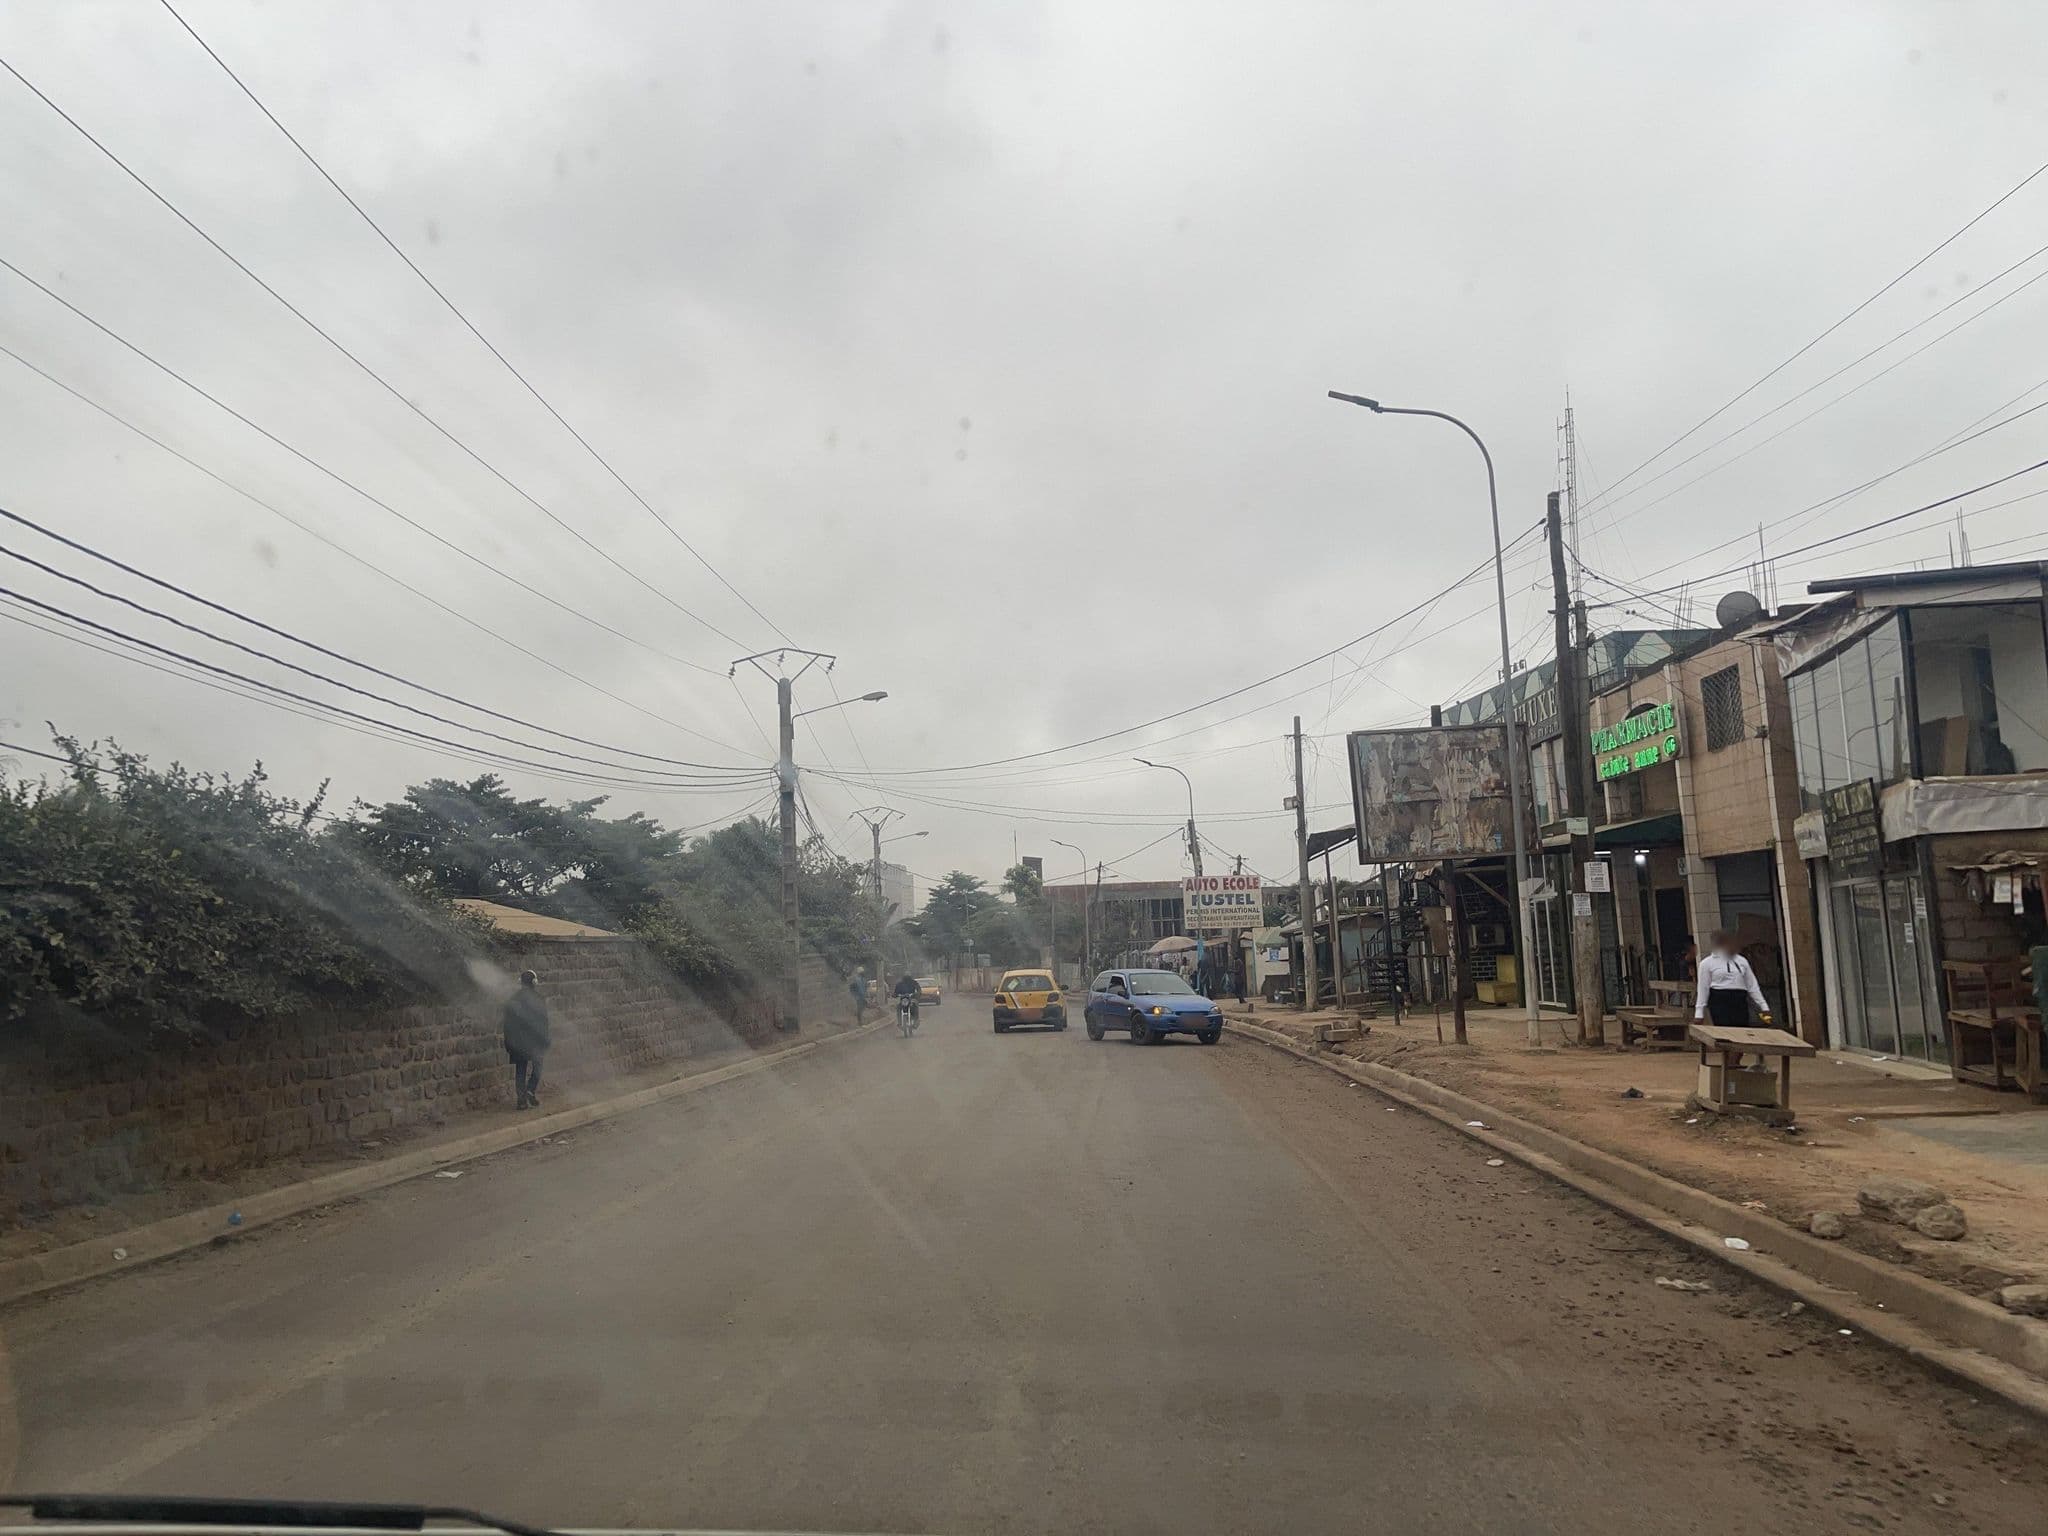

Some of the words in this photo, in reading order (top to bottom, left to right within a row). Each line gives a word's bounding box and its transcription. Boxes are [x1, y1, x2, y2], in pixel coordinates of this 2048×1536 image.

[1591, 703, 1674, 755] PHARMACIE
[1186, 878, 1218, 891] AUTO
[1223, 877, 1259, 890] ECOLE
